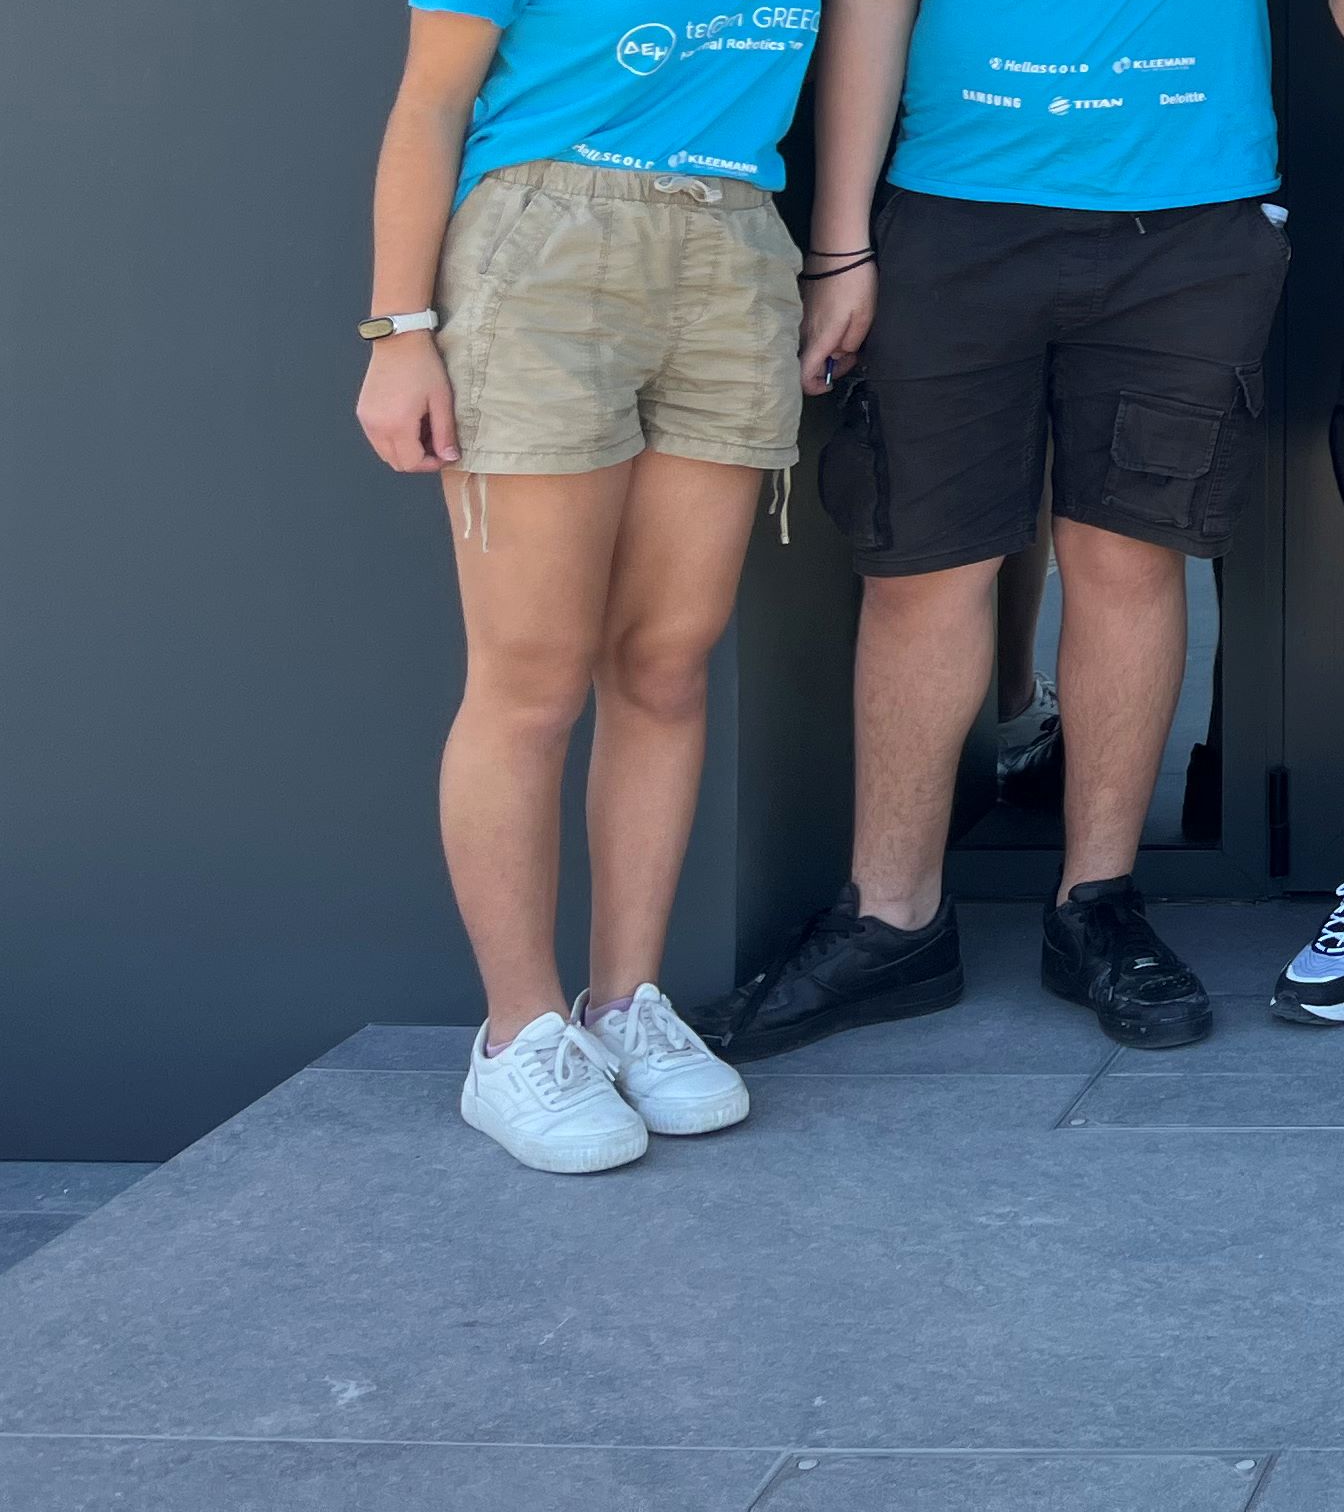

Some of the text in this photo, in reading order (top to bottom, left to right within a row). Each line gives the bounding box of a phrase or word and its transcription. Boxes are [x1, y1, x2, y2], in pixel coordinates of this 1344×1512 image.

[1132, 57, 1196, 69] KLEEMANN
[963, 90, 1021, 108] SAMSUNG
[1074, 98, 1123, 108] TITAN
